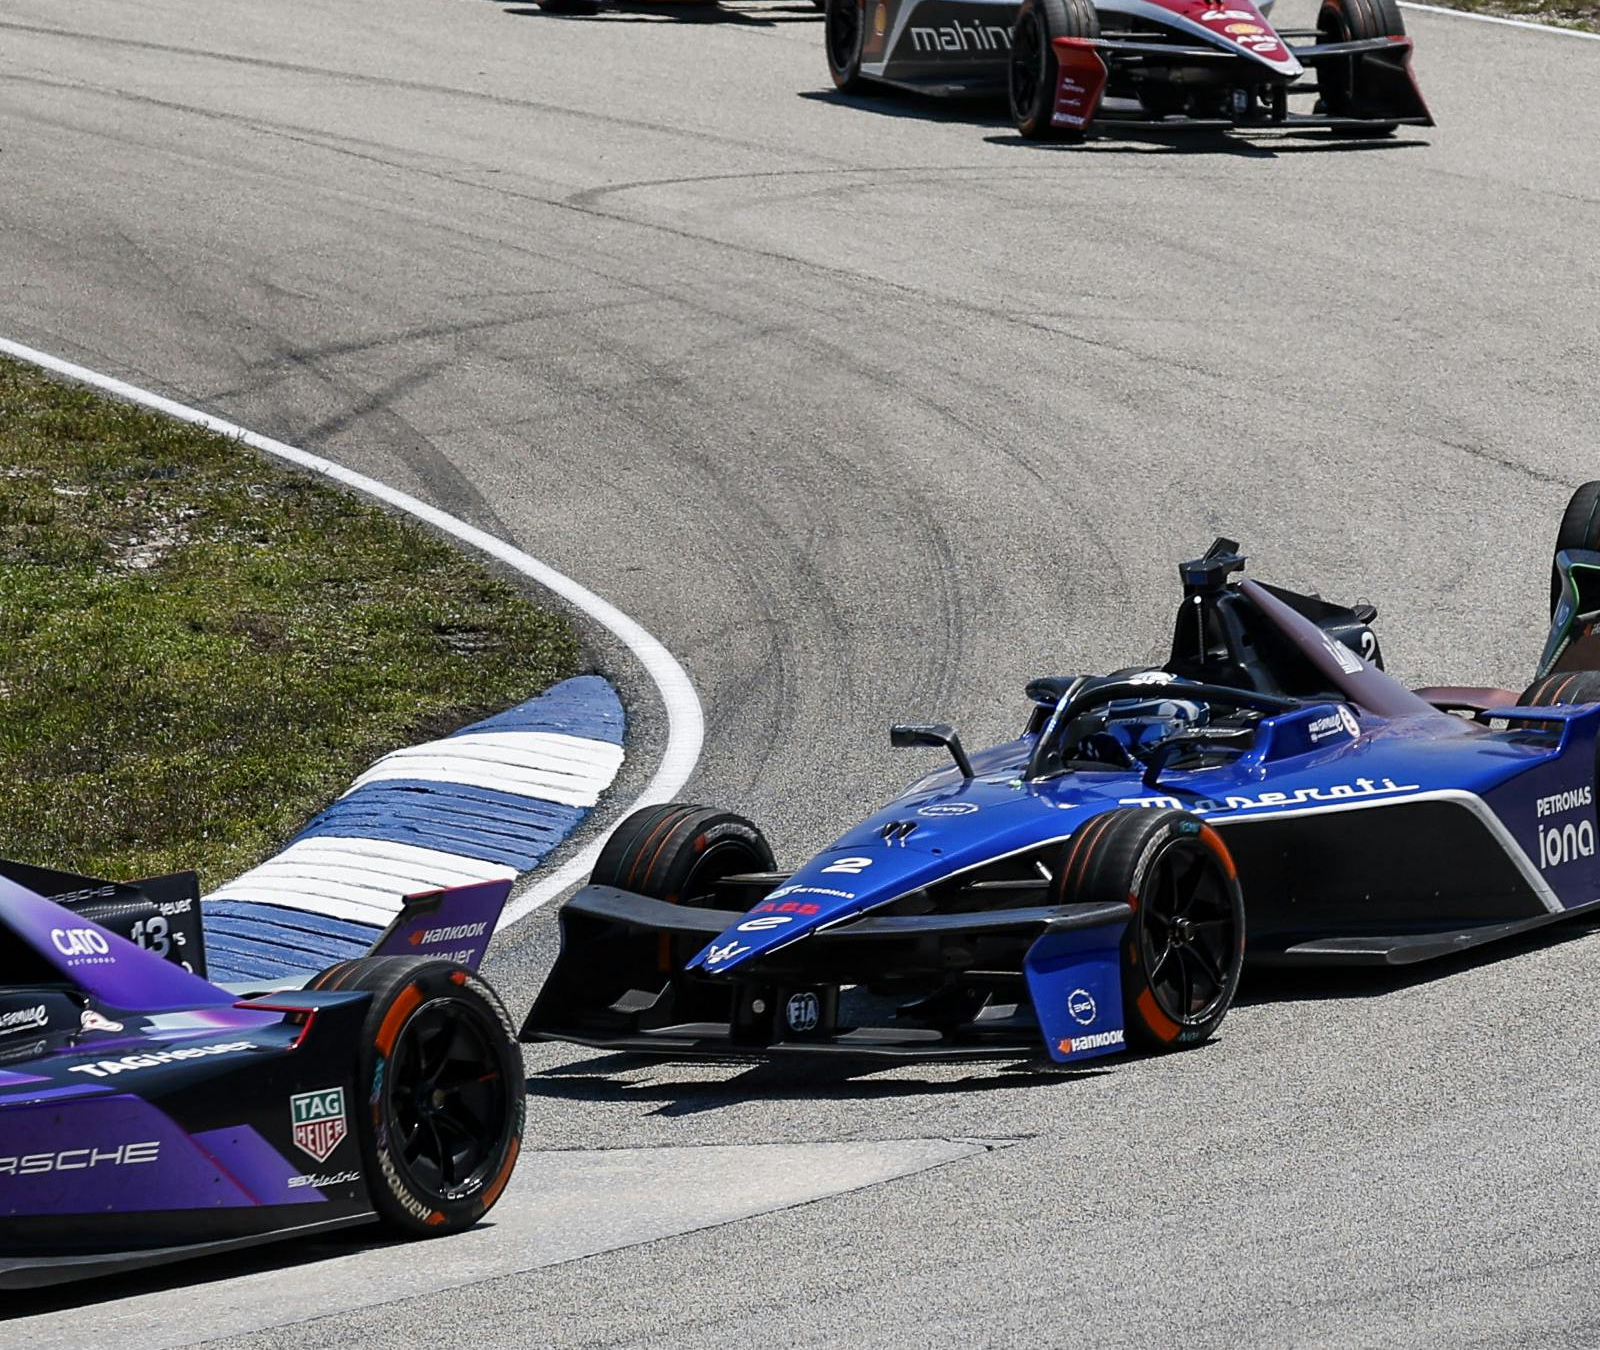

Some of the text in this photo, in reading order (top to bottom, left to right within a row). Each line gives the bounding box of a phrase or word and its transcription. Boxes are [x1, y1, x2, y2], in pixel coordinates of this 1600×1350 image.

[910, 18, 1015, 51] mahin
[1361, 631, 1377, 667] 2
[1536, 786, 1592, 818] PETRONAS
[1537, 819, 1596, 869] iona
[820, 856, 873, 874] 2
[792, 885, 856, 900] PETRONAS
[751, 902, 822, 915] ABB
[50, 928, 110, 957] CATO
[296, 1091, 341, 1120] TAG
[295, 1117, 345, 1157] HEUER
